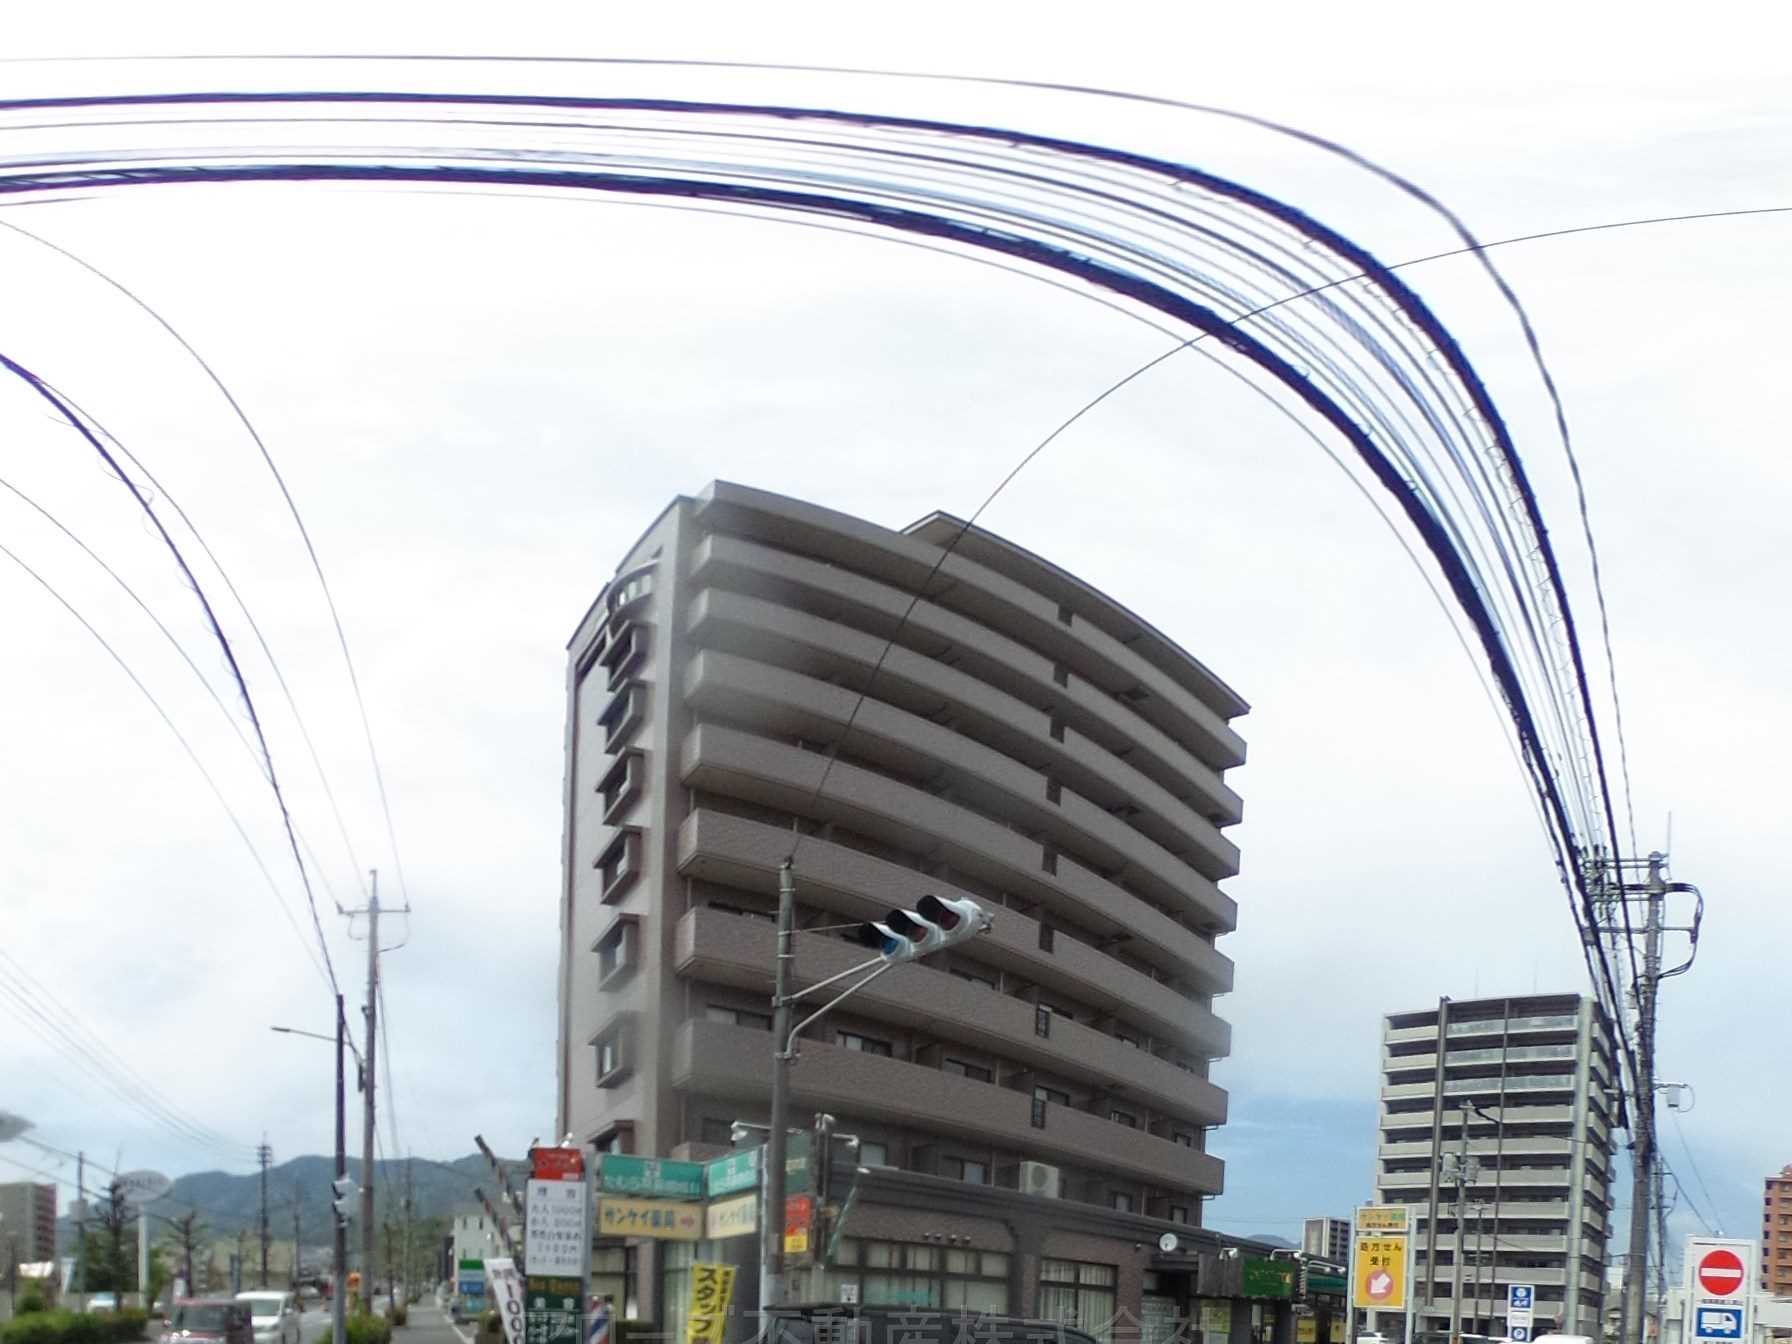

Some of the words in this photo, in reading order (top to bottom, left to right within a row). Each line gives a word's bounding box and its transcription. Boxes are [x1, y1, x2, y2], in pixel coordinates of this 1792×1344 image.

[1360, 1242, 1402, 1252] 処方せん
[1369, 1256, 1391, 1266] 受付
